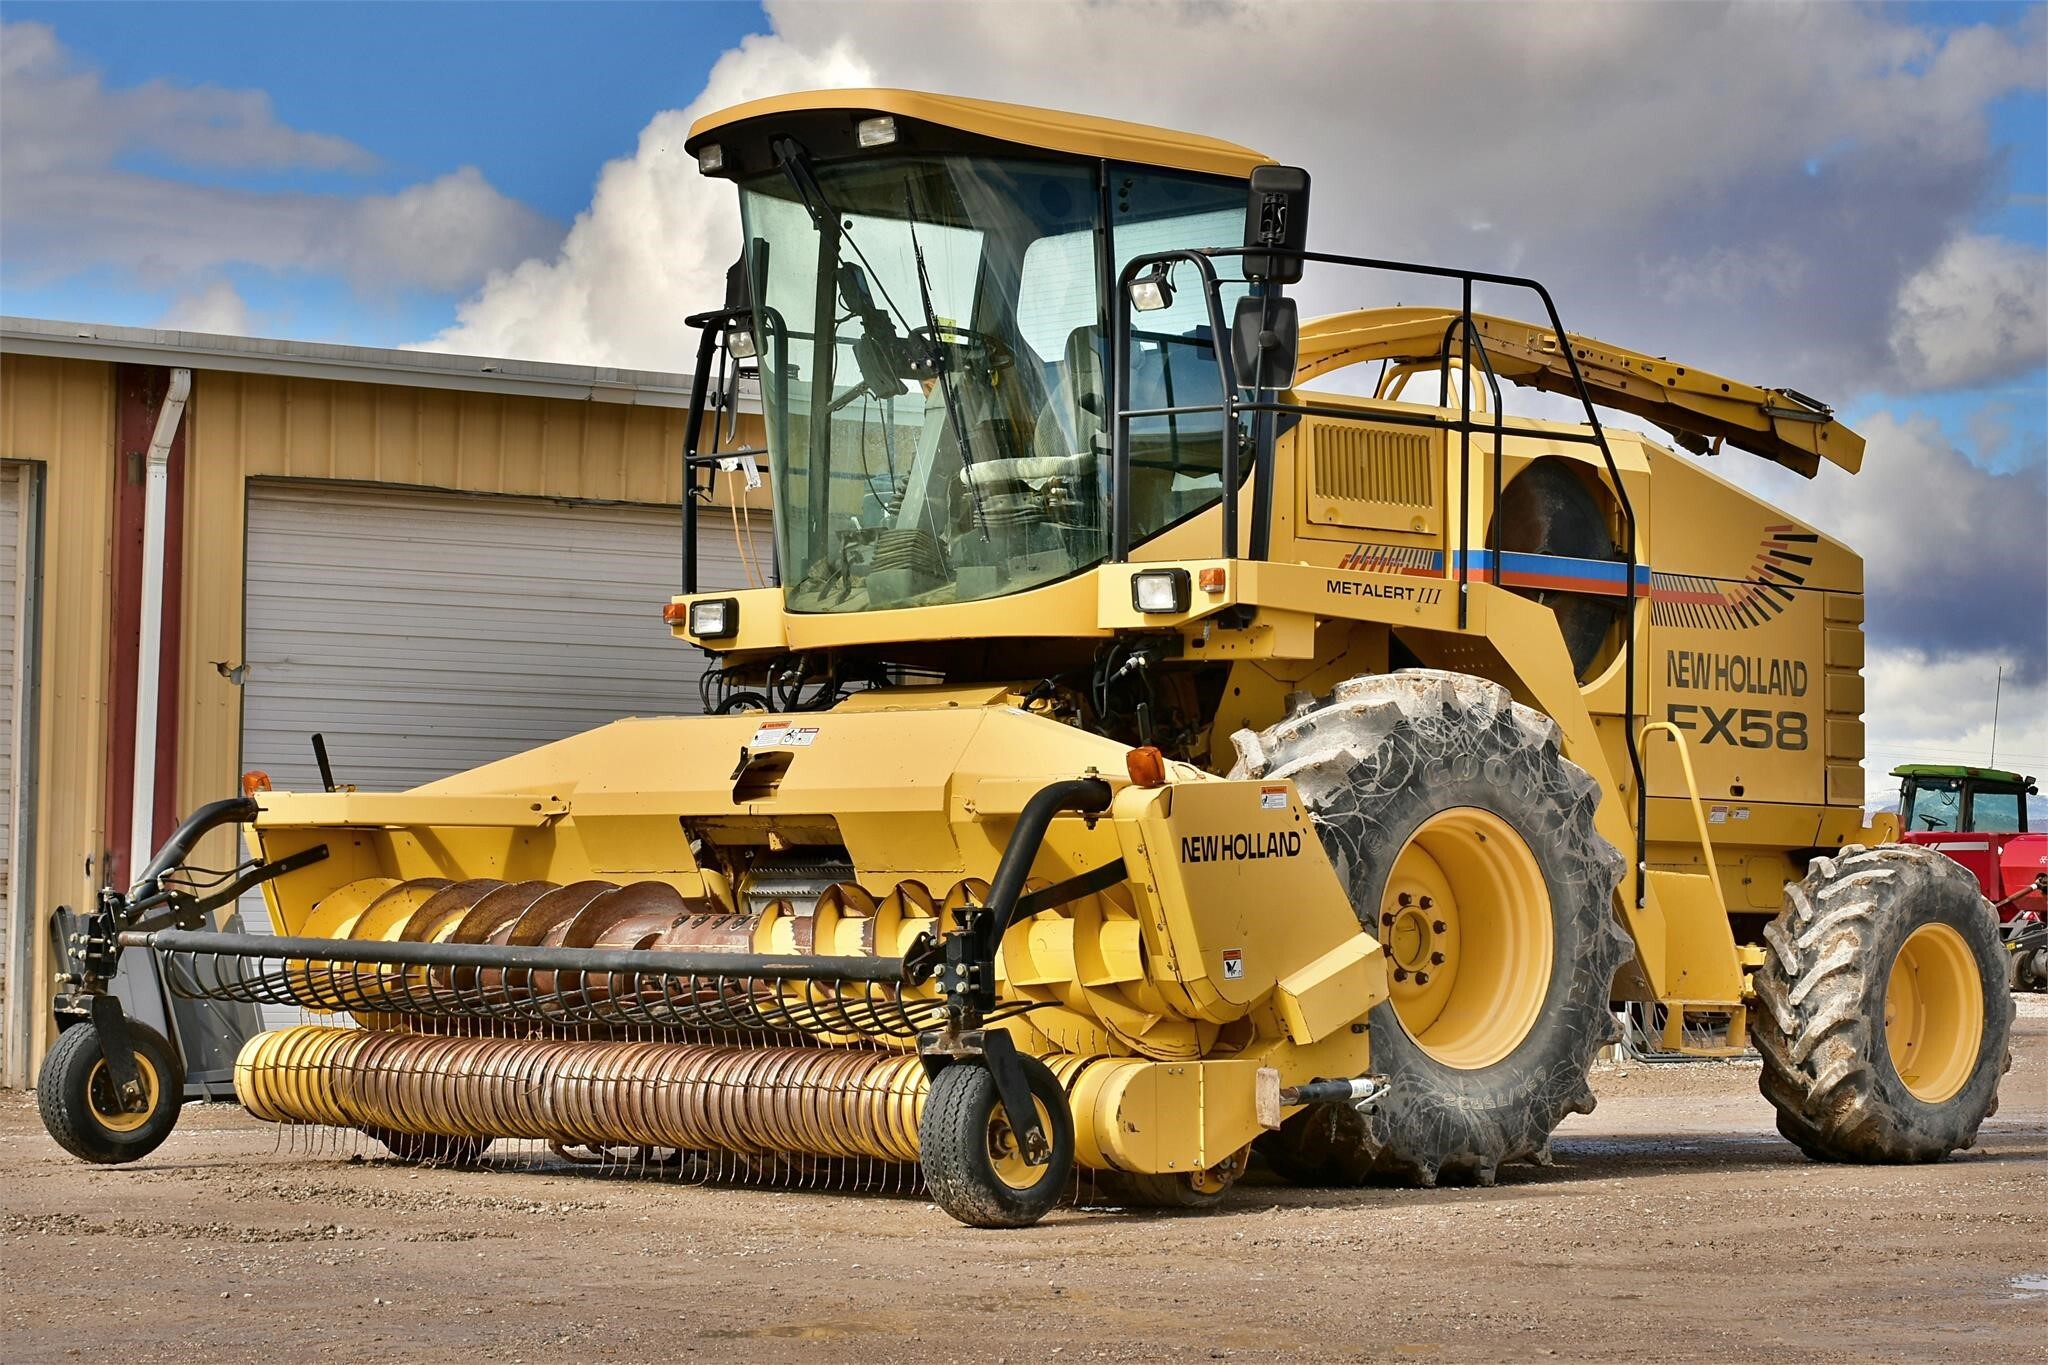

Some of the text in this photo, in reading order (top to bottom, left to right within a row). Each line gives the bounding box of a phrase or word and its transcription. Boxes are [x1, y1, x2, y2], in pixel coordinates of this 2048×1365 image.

[1327, 580, 1414, 600] METALERT
[1667, 650, 1807, 697] NEW HOLLAND
[1667, 703, 1808, 751] FX58
[1182, 831, 1301, 863] NEW HOLLAND
